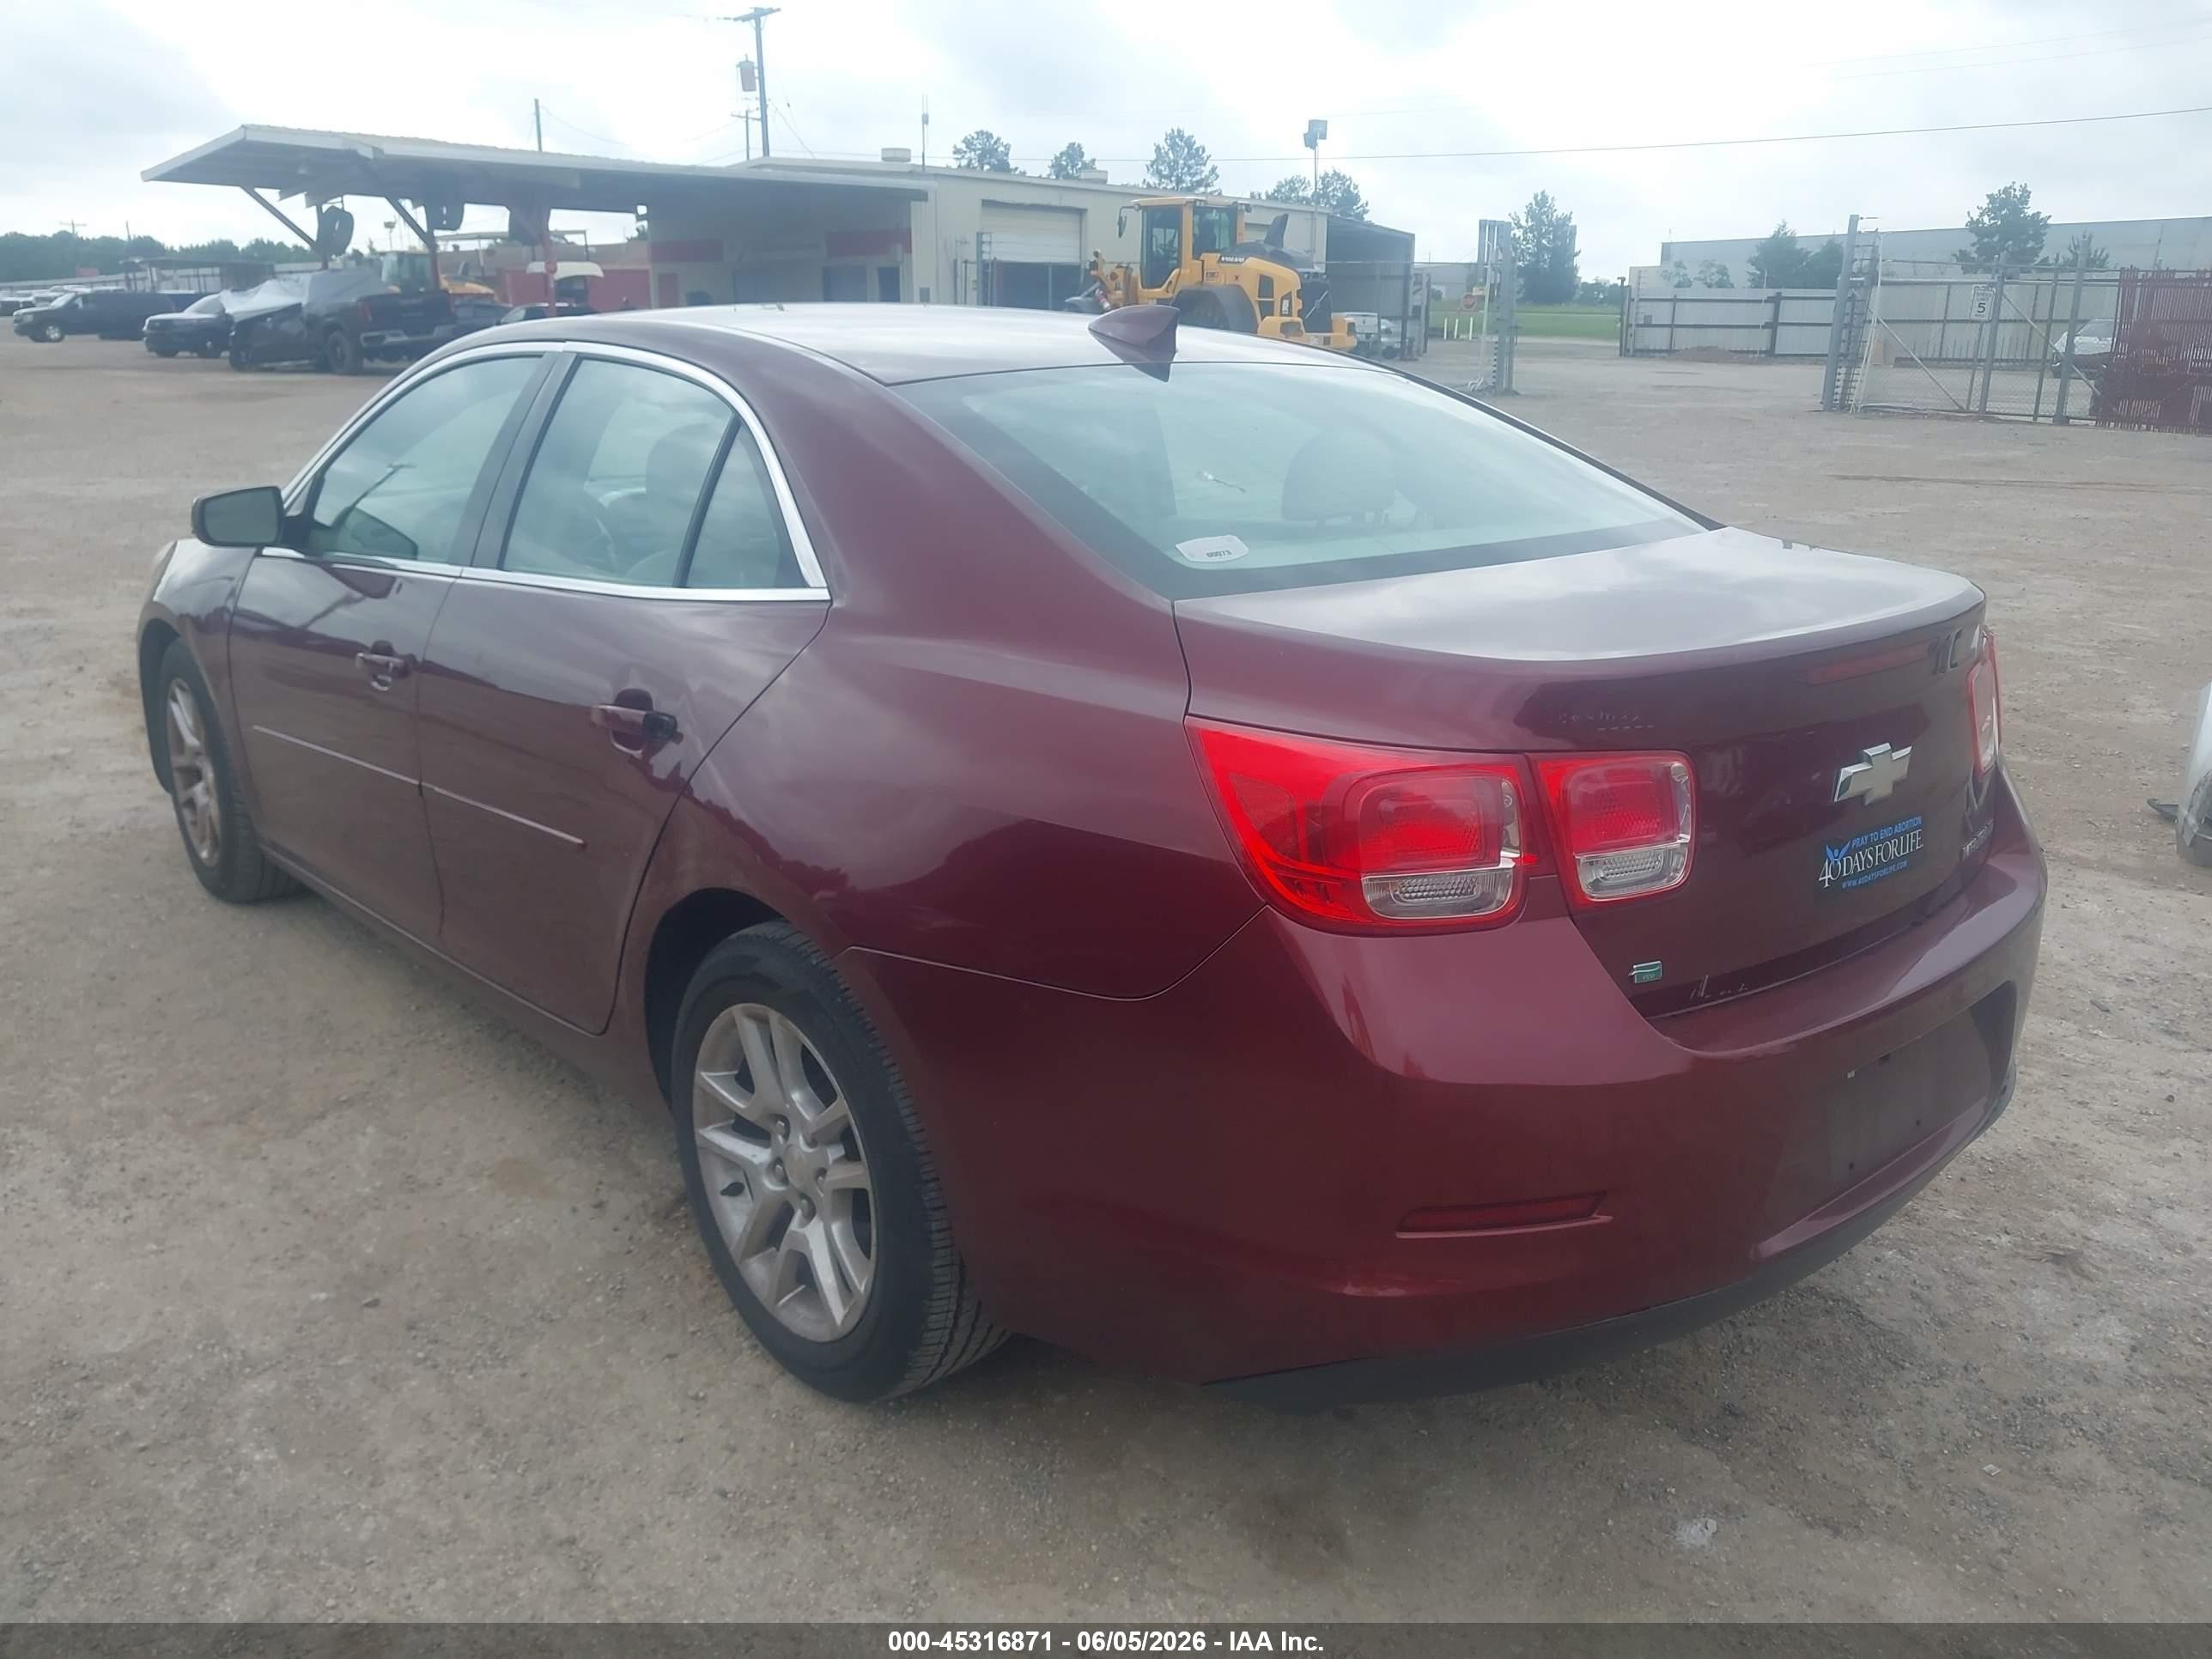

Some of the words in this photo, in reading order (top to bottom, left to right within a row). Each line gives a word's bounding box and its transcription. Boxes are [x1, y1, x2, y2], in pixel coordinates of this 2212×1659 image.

[1977, 302, 1986, 313] 5
[1851, 834, 1869, 848] PRAY
[1870, 831, 1879, 842] TO
[1880, 827, 1893, 840] END
[1893, 816, 1923, 835] ABORTION
